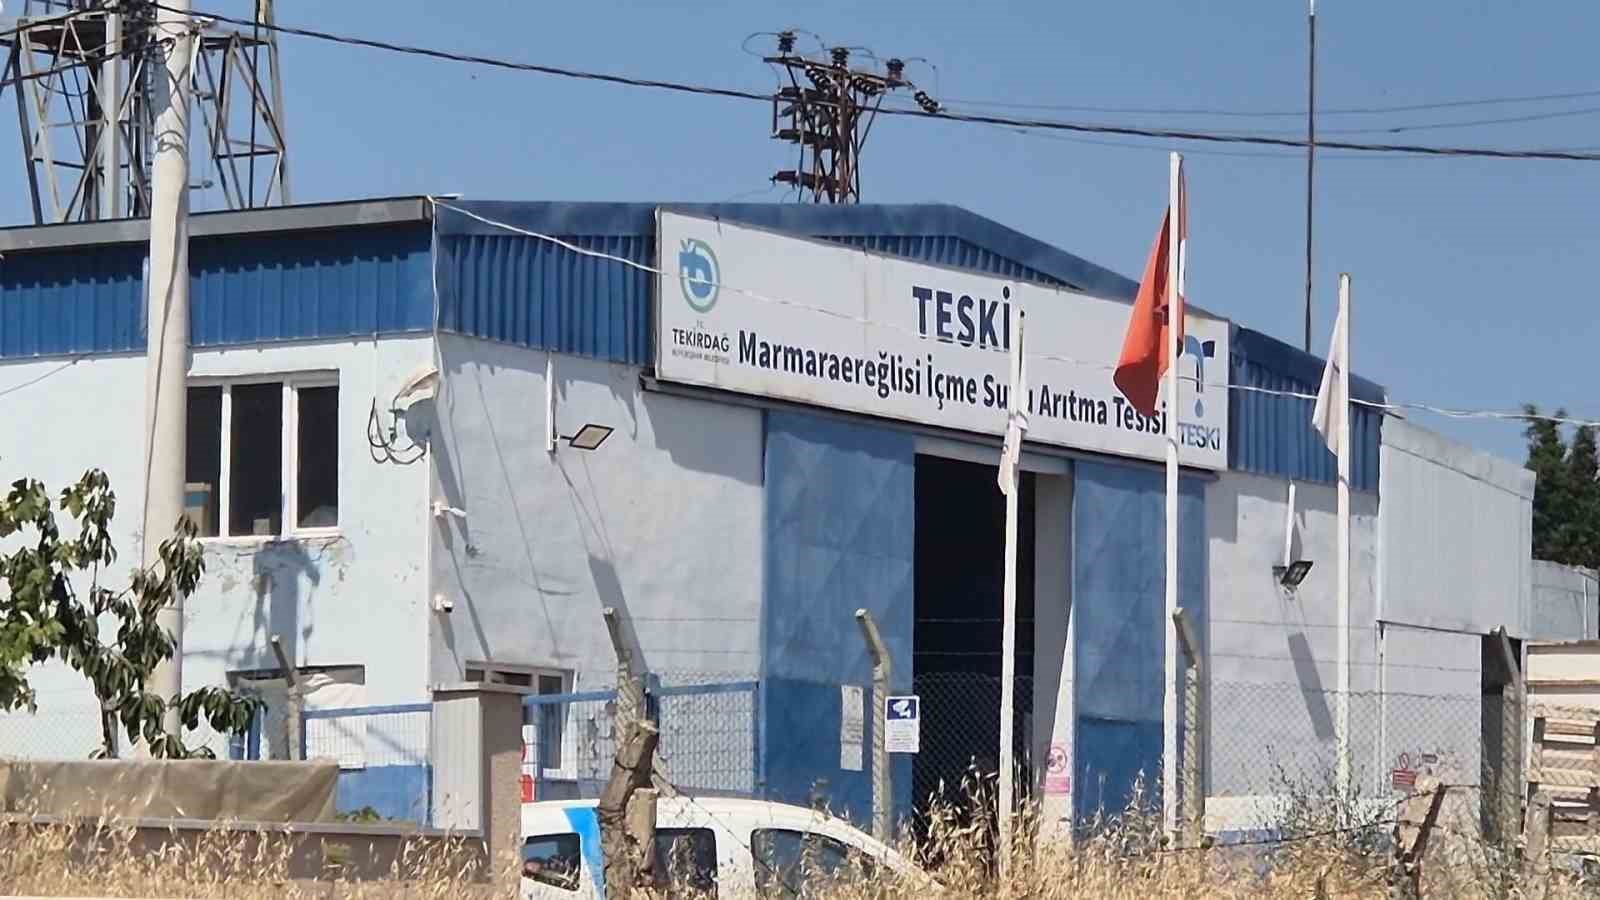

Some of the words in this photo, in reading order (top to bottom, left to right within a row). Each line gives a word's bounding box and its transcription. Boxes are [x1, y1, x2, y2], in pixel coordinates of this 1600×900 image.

[672, 328, 730, 353] TEKİRDAĞ
[912, 285, 1011, 351] TESKİ
[738, 330, 921, 398] Marmaraereğlisi
[927, 354, 977, 410] İçme
[1038, 385, 1108, 426] Arıtma
